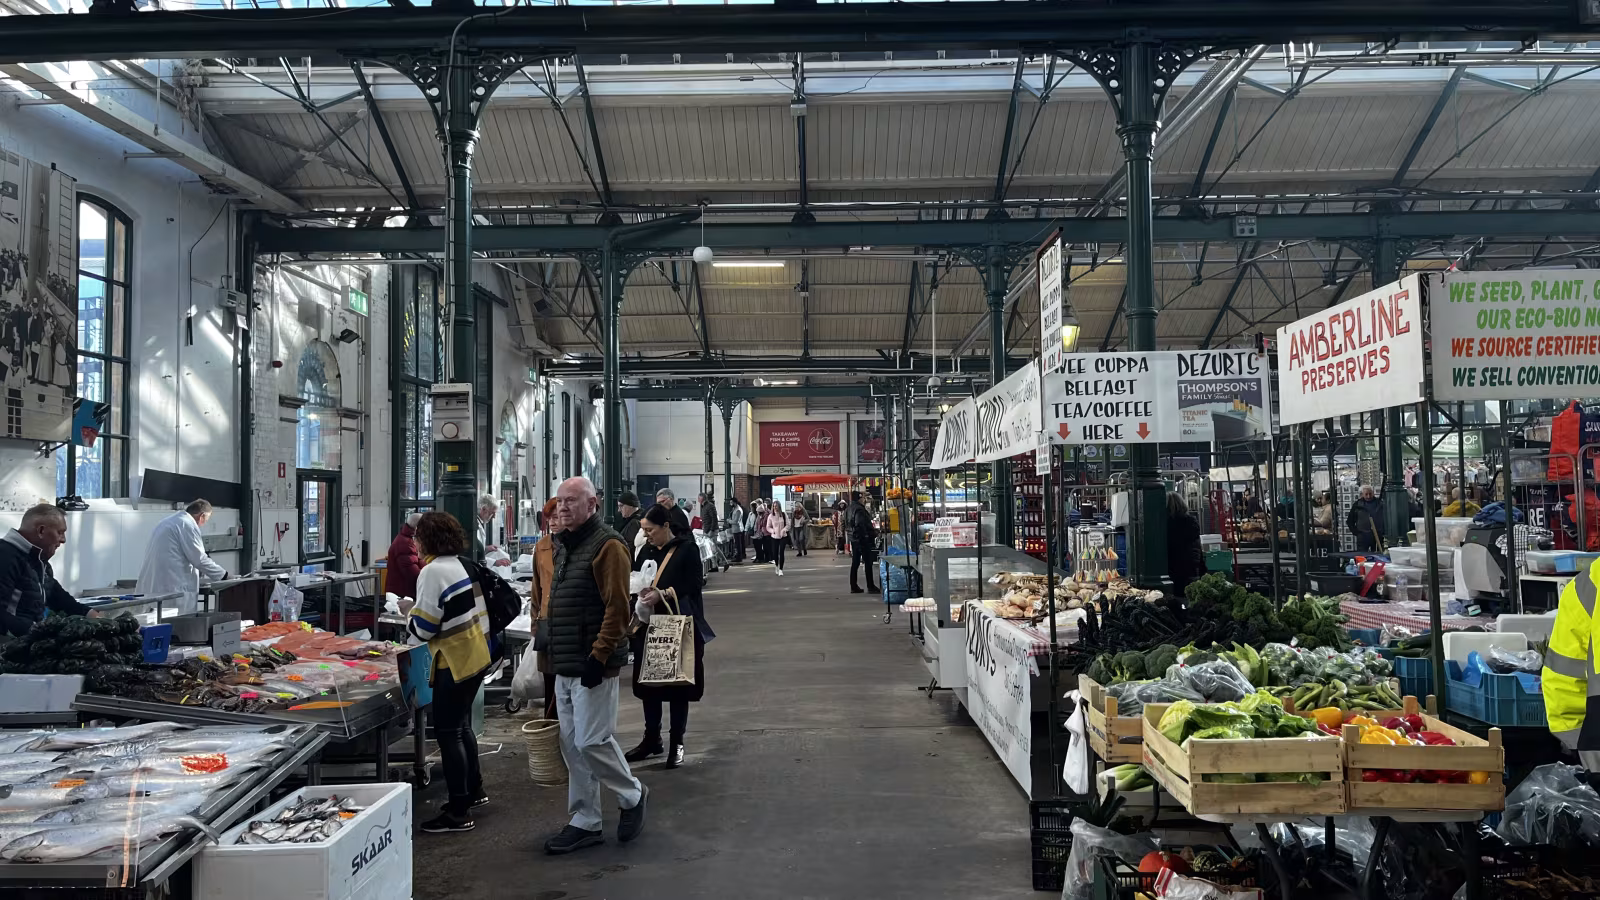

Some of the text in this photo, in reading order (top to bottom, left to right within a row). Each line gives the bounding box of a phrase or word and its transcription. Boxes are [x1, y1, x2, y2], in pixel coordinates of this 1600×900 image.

[1449, 281, 1476, 302] WE
[1480, 280, 1525, 304] SEED,
[1530, 280, 1588, 303] PLANT,
[1476, 308, 1511, 330] OUR
[1515, 307, 1581, 329] ECO-BIO
[1451, 338, 1475, 357] WE
[1477, 336, 1533, 357] SOURCE
[1094, 357, 1149, 374] CUPPA
[1177, 352, 1259, 377] DEZURTS
[1301, 345, 1391, 394] PRESERVES
[1452, 365, 1600, 387] WE SELL CONVENTIO
[1064, 379, 1137, 396] BELFAST
[1179, 382, 1257, 393] THOMPSON'S
[1051, 401, 1153, 419] TEA/COFFEE
[1083, 424, 1123, 440] HERE
[351, 829, 392, 876] SKAAR
